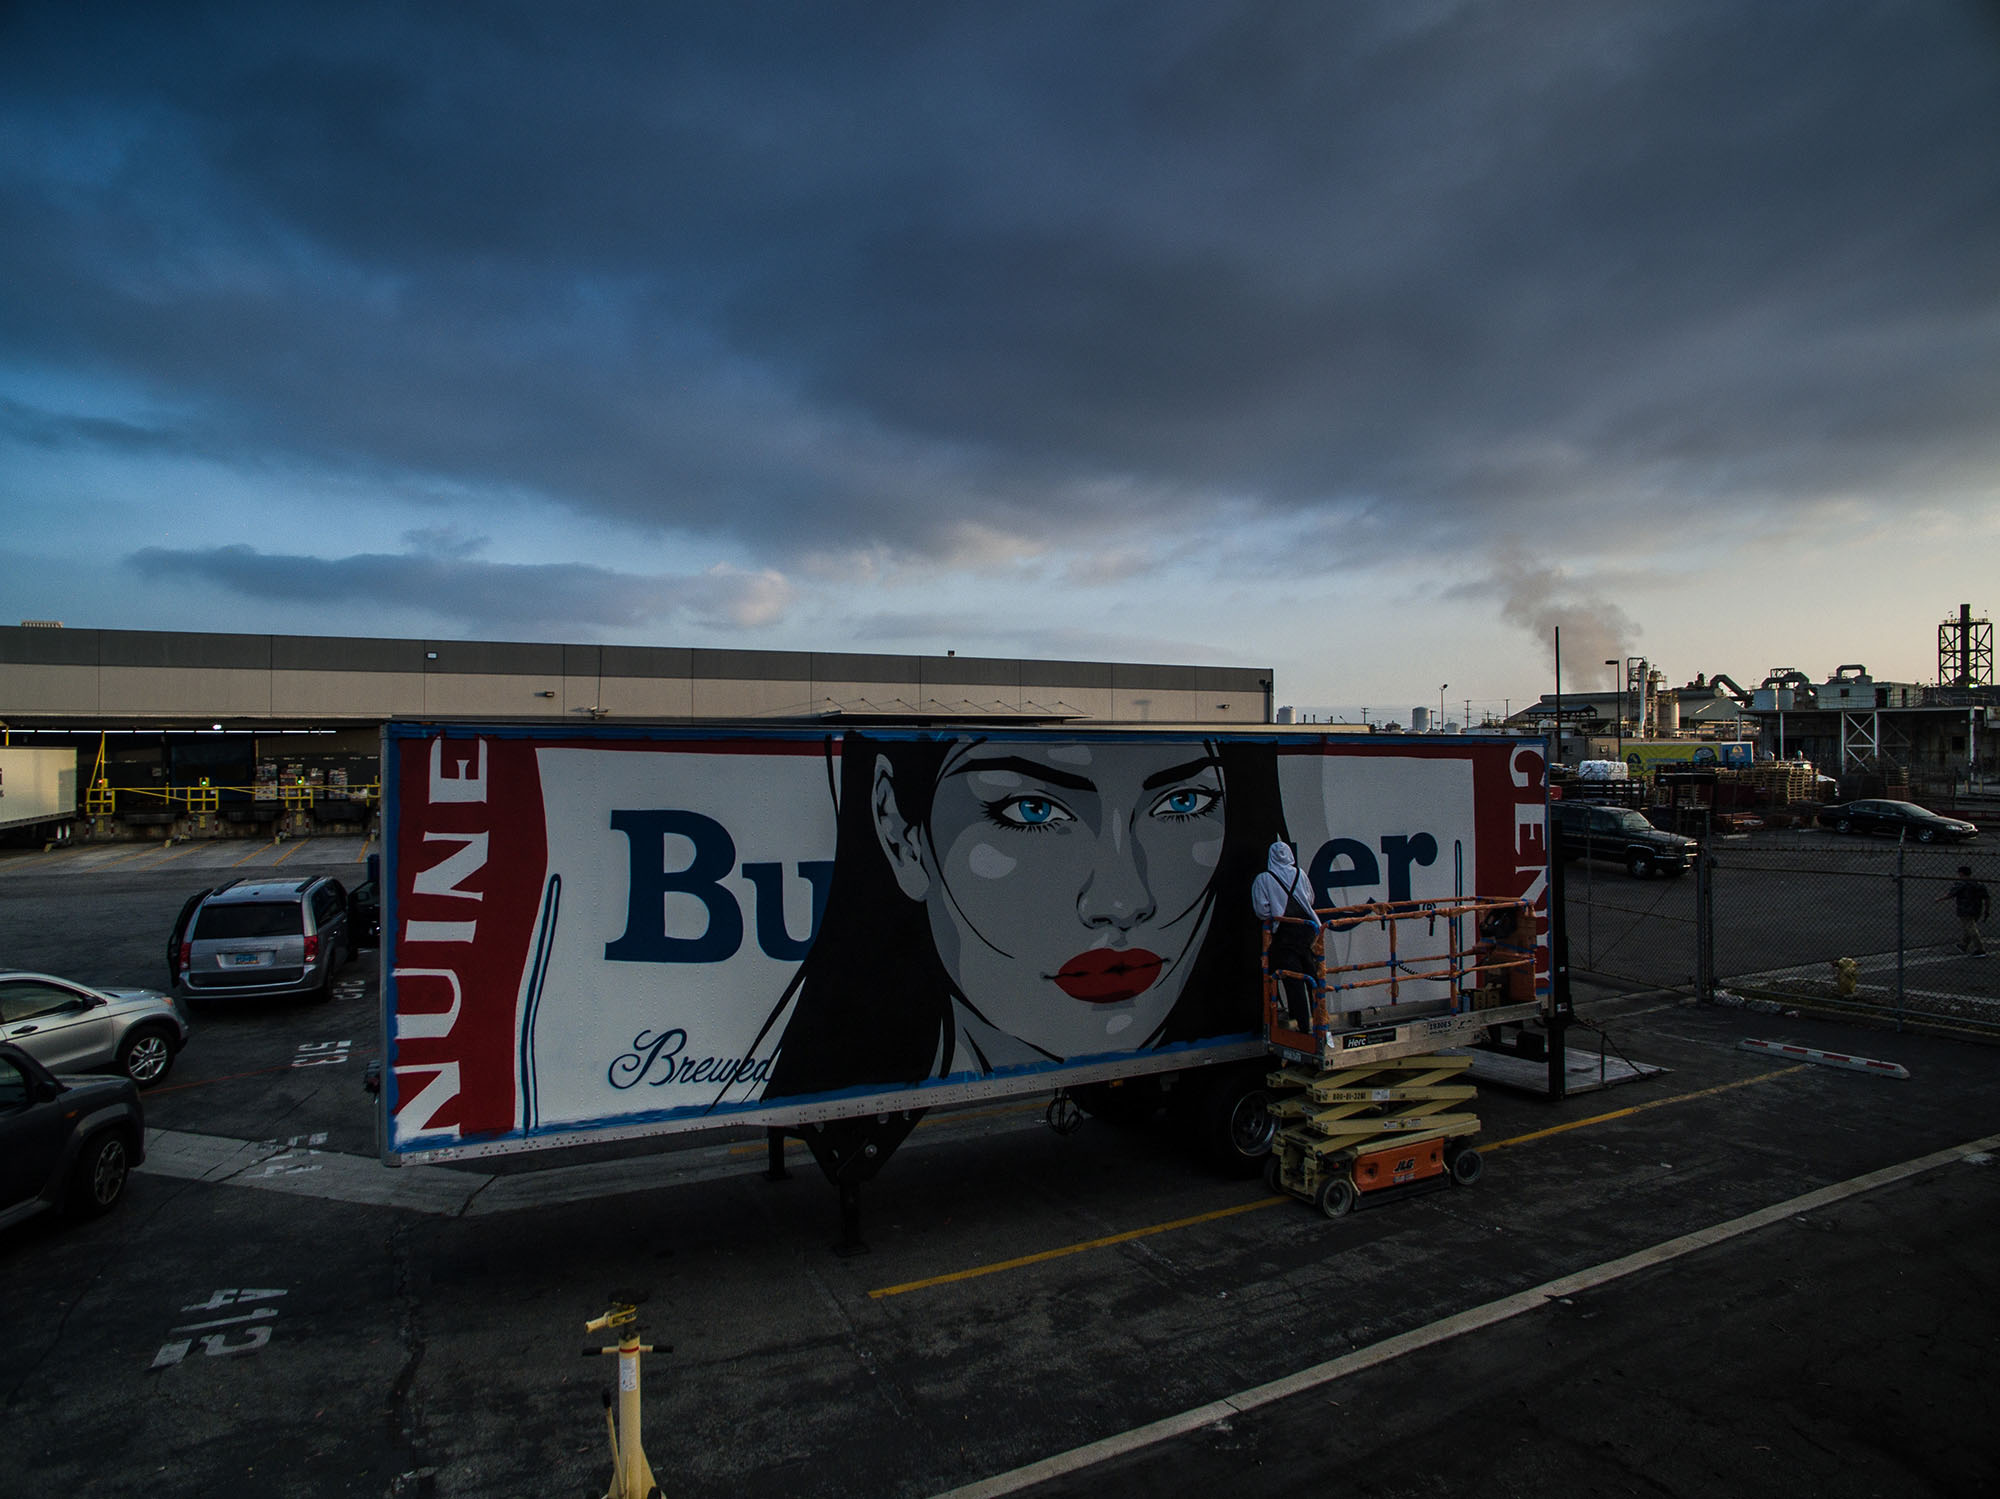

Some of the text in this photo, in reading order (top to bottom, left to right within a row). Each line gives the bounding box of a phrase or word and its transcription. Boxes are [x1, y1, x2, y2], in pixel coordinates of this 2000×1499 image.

[605, 810, 1438, 962] Bu er
[1509, 744, 1551, 982] GEN
[394, 735, 490, 1143] NUINE
[608, 1028, 774, 1089] Brewed
[1347, 1037, 1368, 1048] Herc
[143, 1288, 288, 1371] 412
